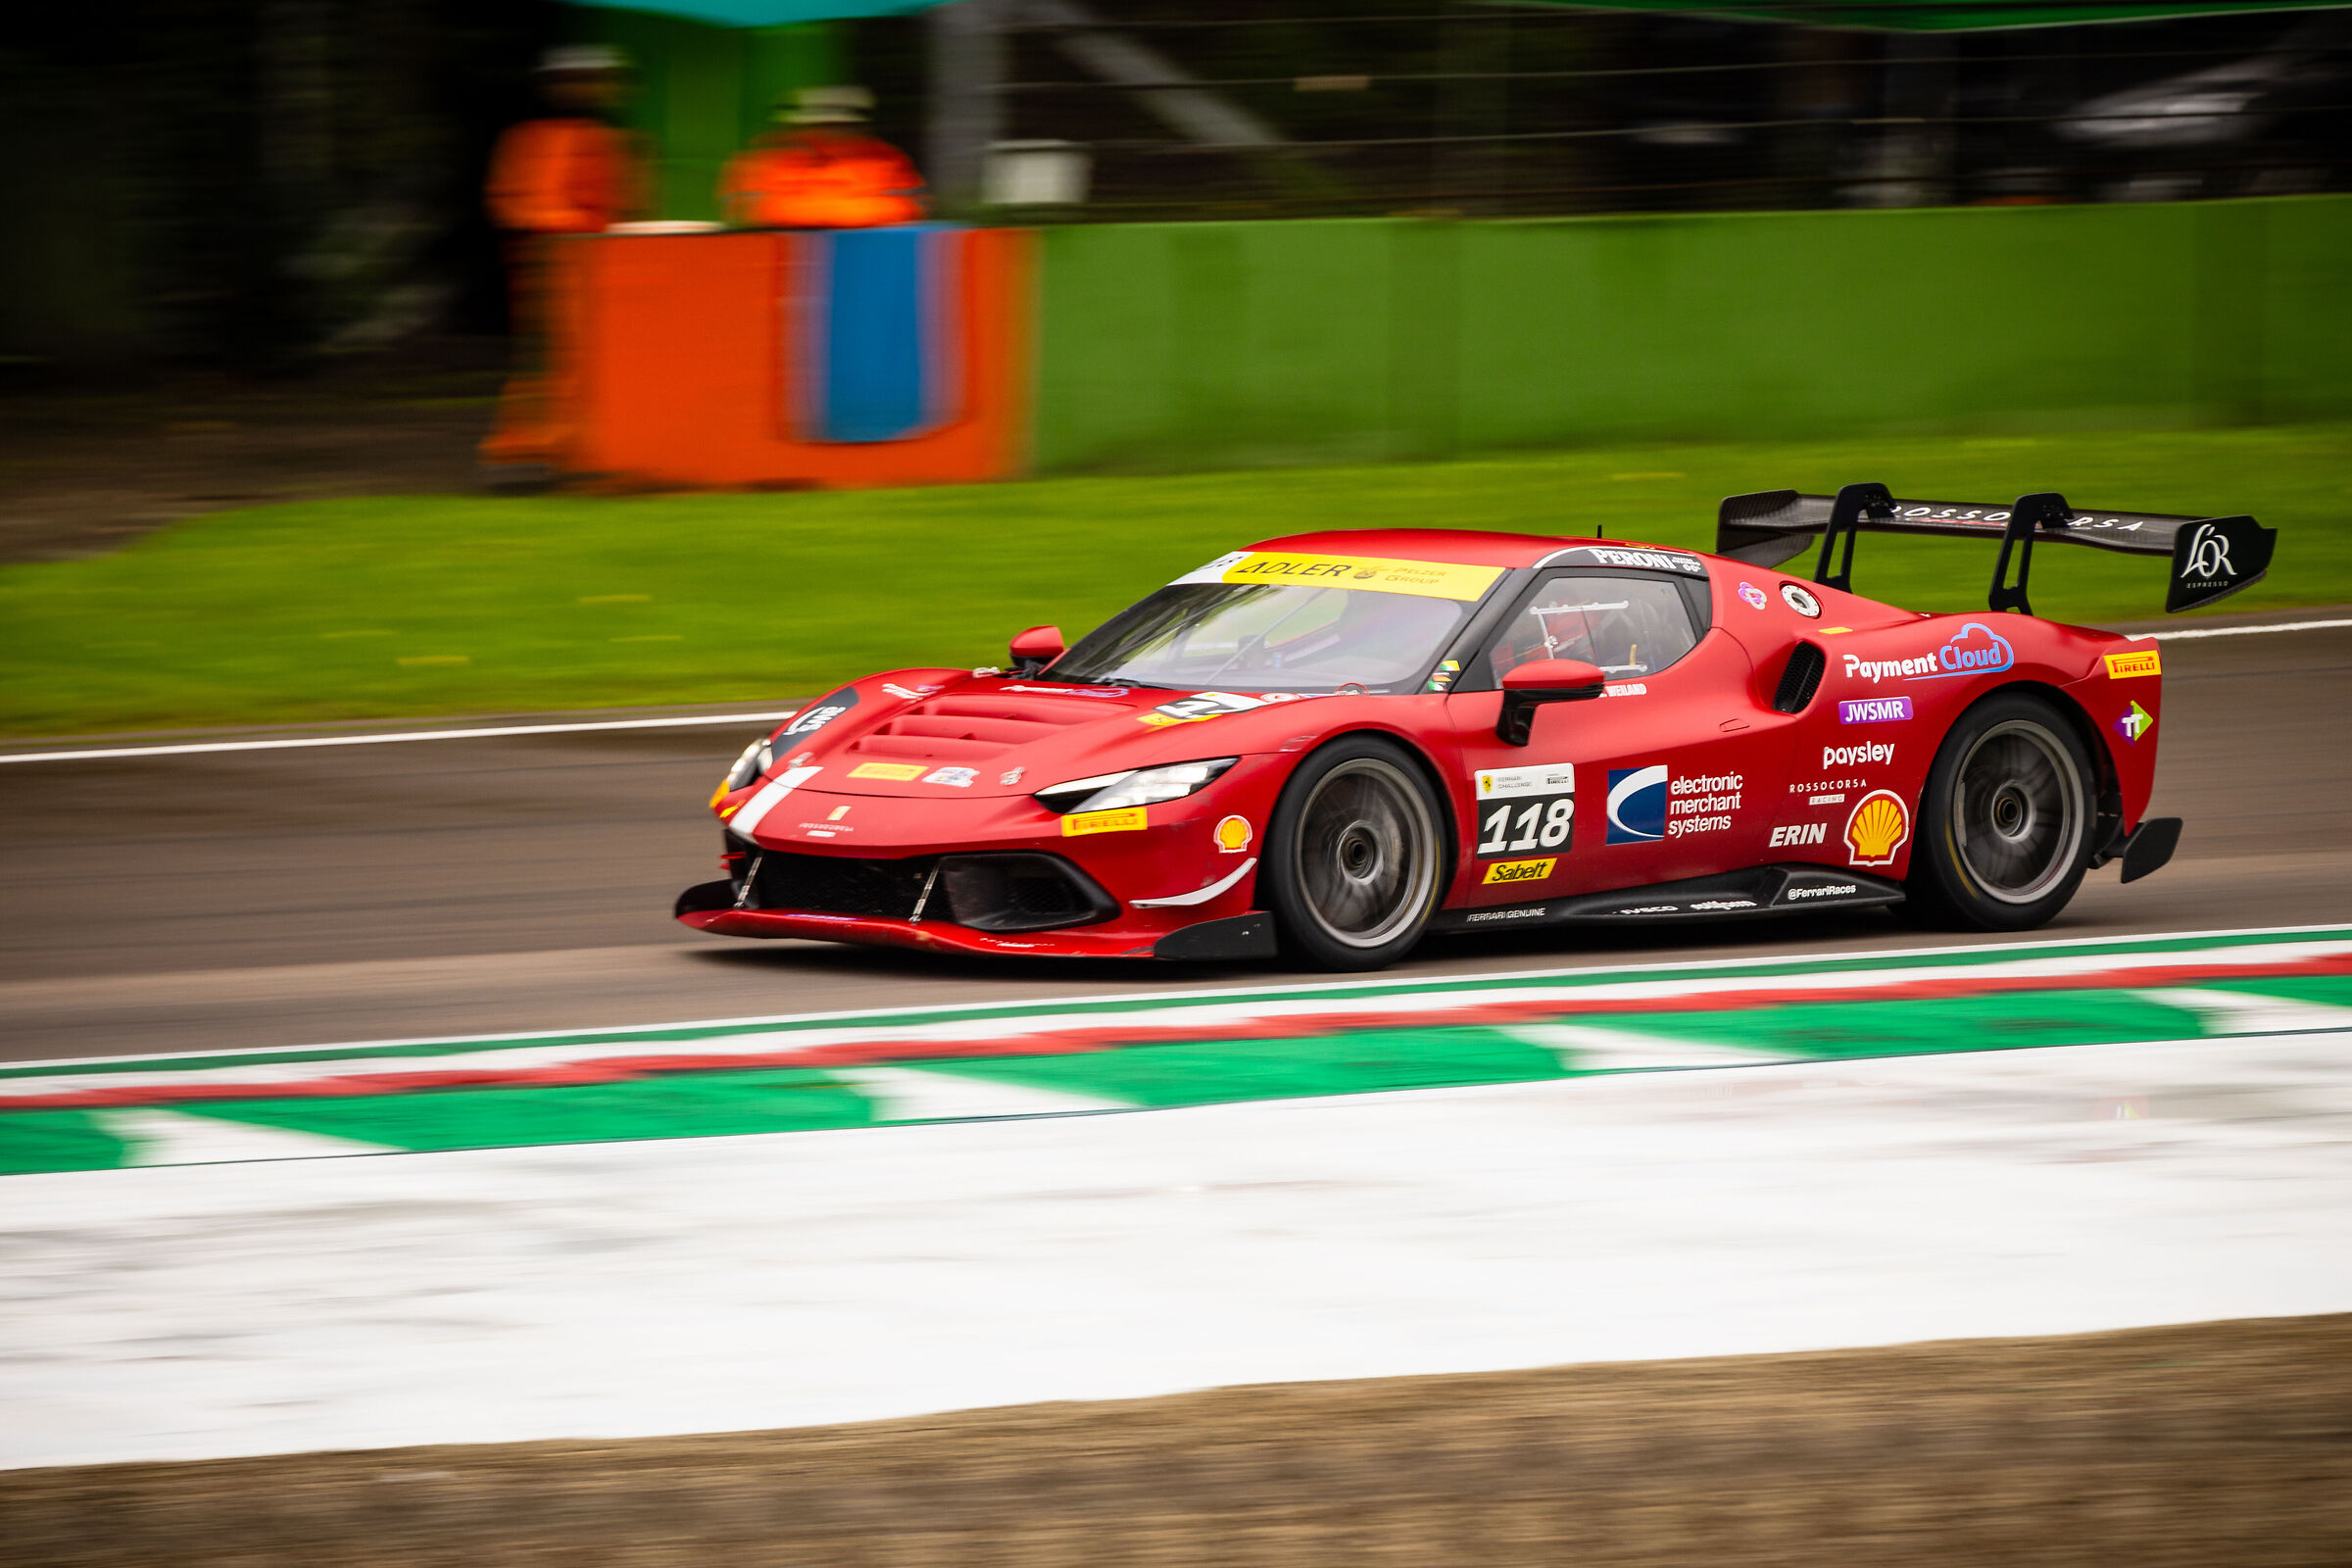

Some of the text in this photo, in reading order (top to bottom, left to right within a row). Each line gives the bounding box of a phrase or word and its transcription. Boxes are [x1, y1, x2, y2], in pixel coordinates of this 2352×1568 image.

[1588, 548, 1678, 569] PERONI
[1235, 561, 1352, 578] ADLER
[1385, 574, 1441, 585] GROUP
[2186, 580, 2230, 589] ESPRESSO
[1842, 641, 2002, 684] Payment Cloud
[2111, 656, 2156, 673] PIRELLI
[1845, 701, 1905, 722] JWSMR
[1823, 740, 1895, 769] paysley
[1670, 771, 1743, 796] electronic
[1789, 778, 1867, 793] ROSSOCORSA
[1669, 792, 1741, 815] merchant
[1477, 799, 1575, 855] 118
[1667, 814, 1732, 839] systems
[1769, 823, 1828, 848] ERIN
[1492, 861, 1547, 881] Sabelt
[1788, 884, 1857, 901] @FerrariRaces
[1466, 907, 1546, 922] FERRARI GENUINE
